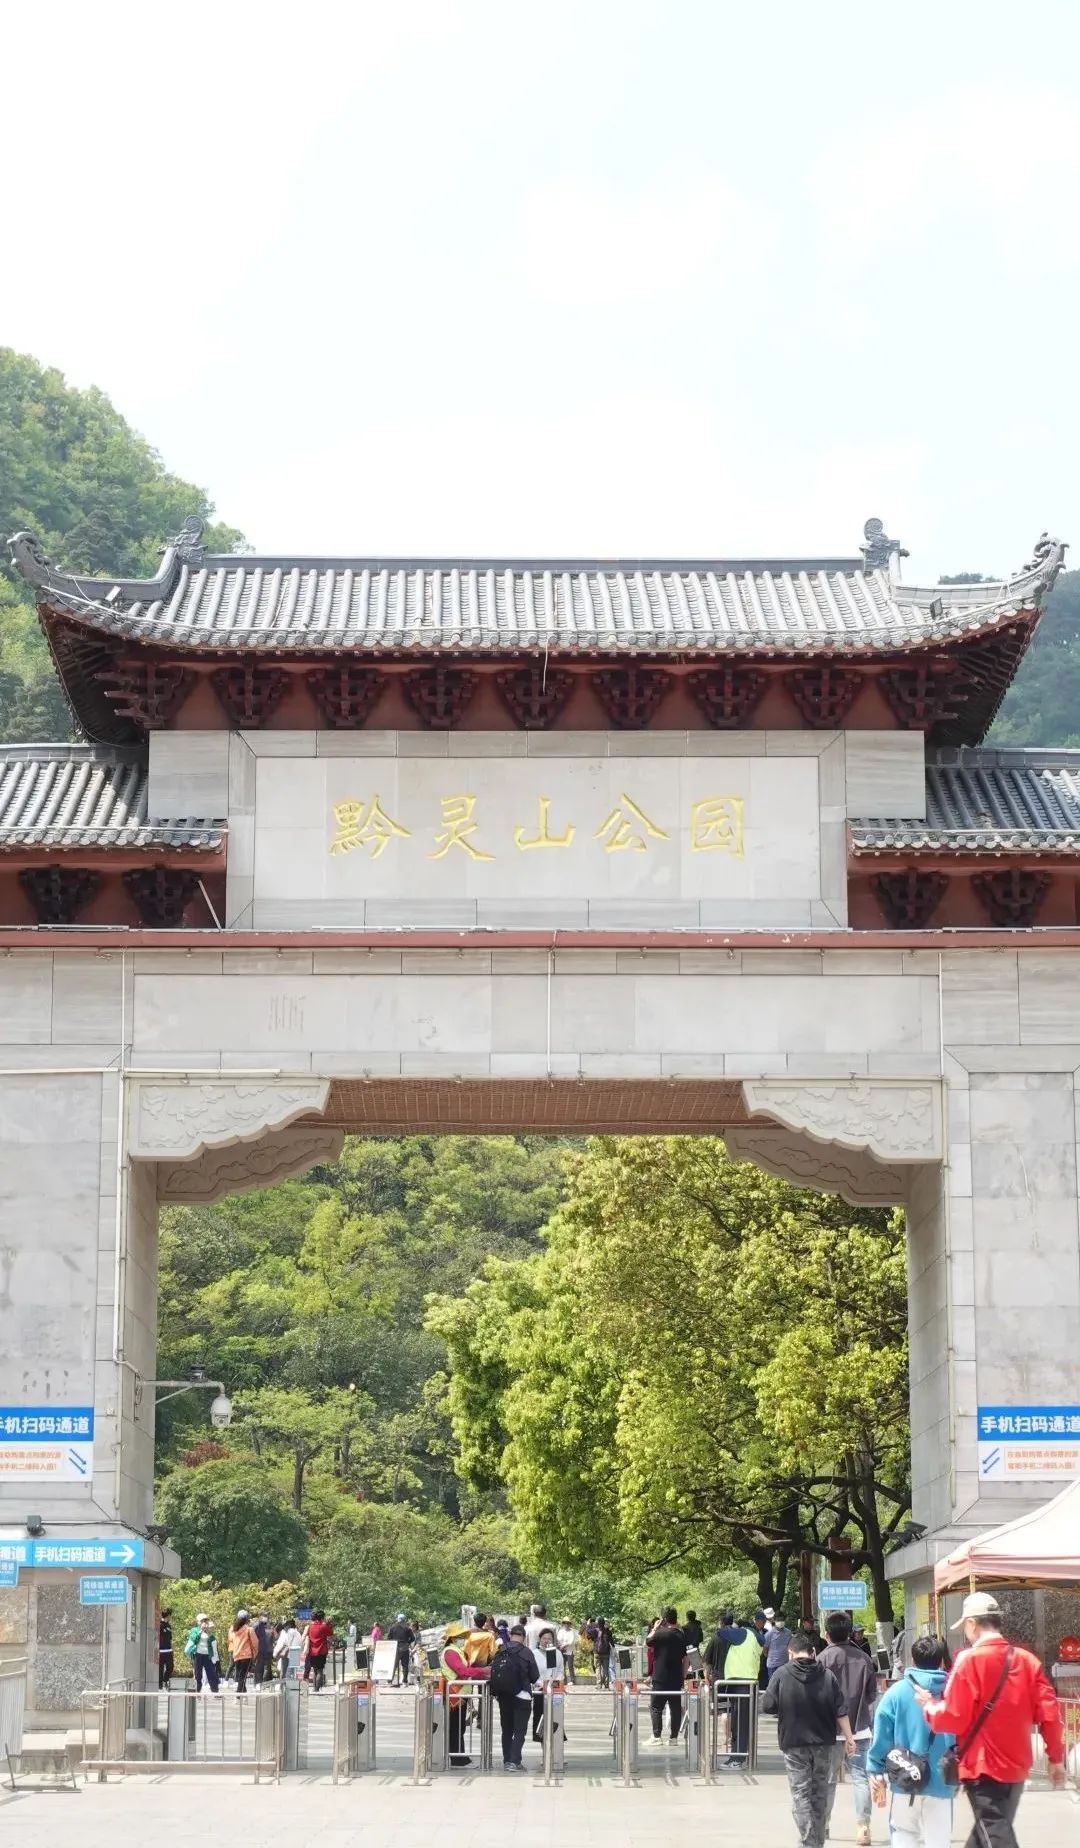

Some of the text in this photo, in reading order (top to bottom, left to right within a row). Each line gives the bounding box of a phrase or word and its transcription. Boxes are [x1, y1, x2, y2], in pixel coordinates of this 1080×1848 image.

[330, 793, 745, 861] 黔灵山公园
[0, 1416, 90, 1434] 机扫码通道
[981, 1415, 1080, 1434] 手机扫码通道
[35, 1546, 106, 1562] 手机扫码通道
